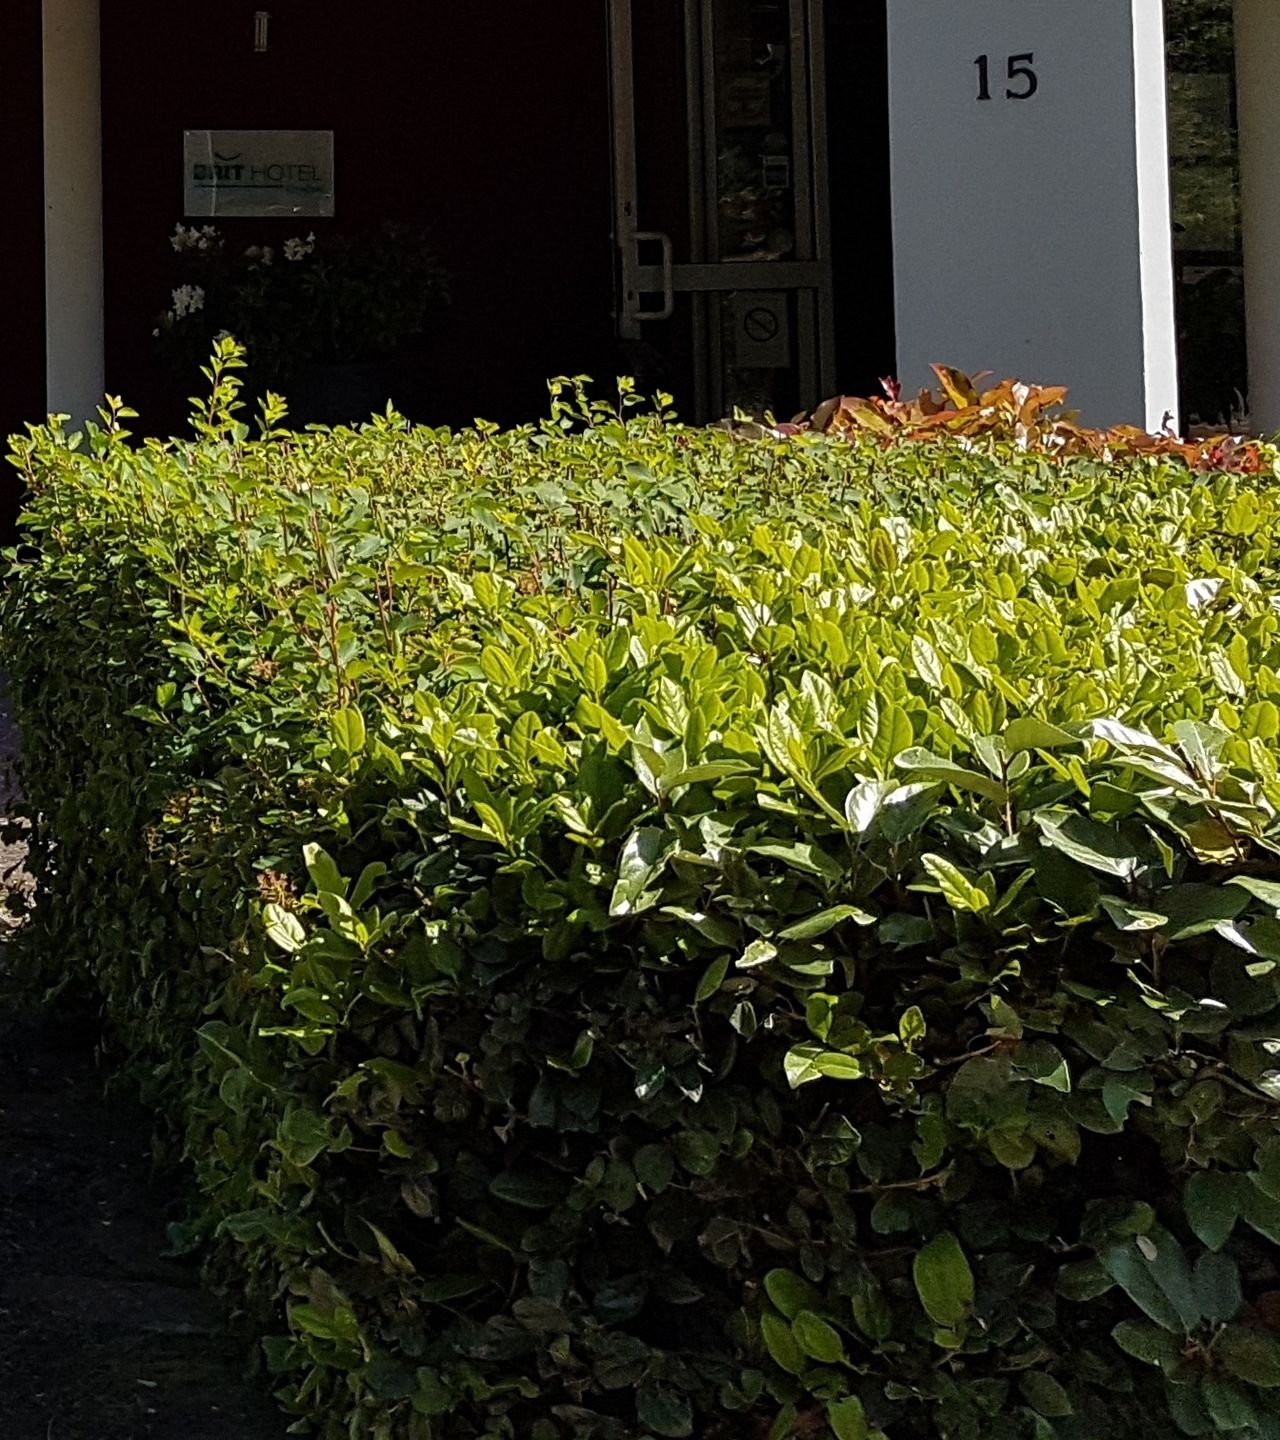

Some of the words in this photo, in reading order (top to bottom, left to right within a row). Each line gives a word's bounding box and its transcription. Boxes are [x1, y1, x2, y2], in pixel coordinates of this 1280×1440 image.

[973, 52, 1039, 101] 15
[193, 163, 245, 180] BRIT
[251, 163, 325, 181] HOTEL
